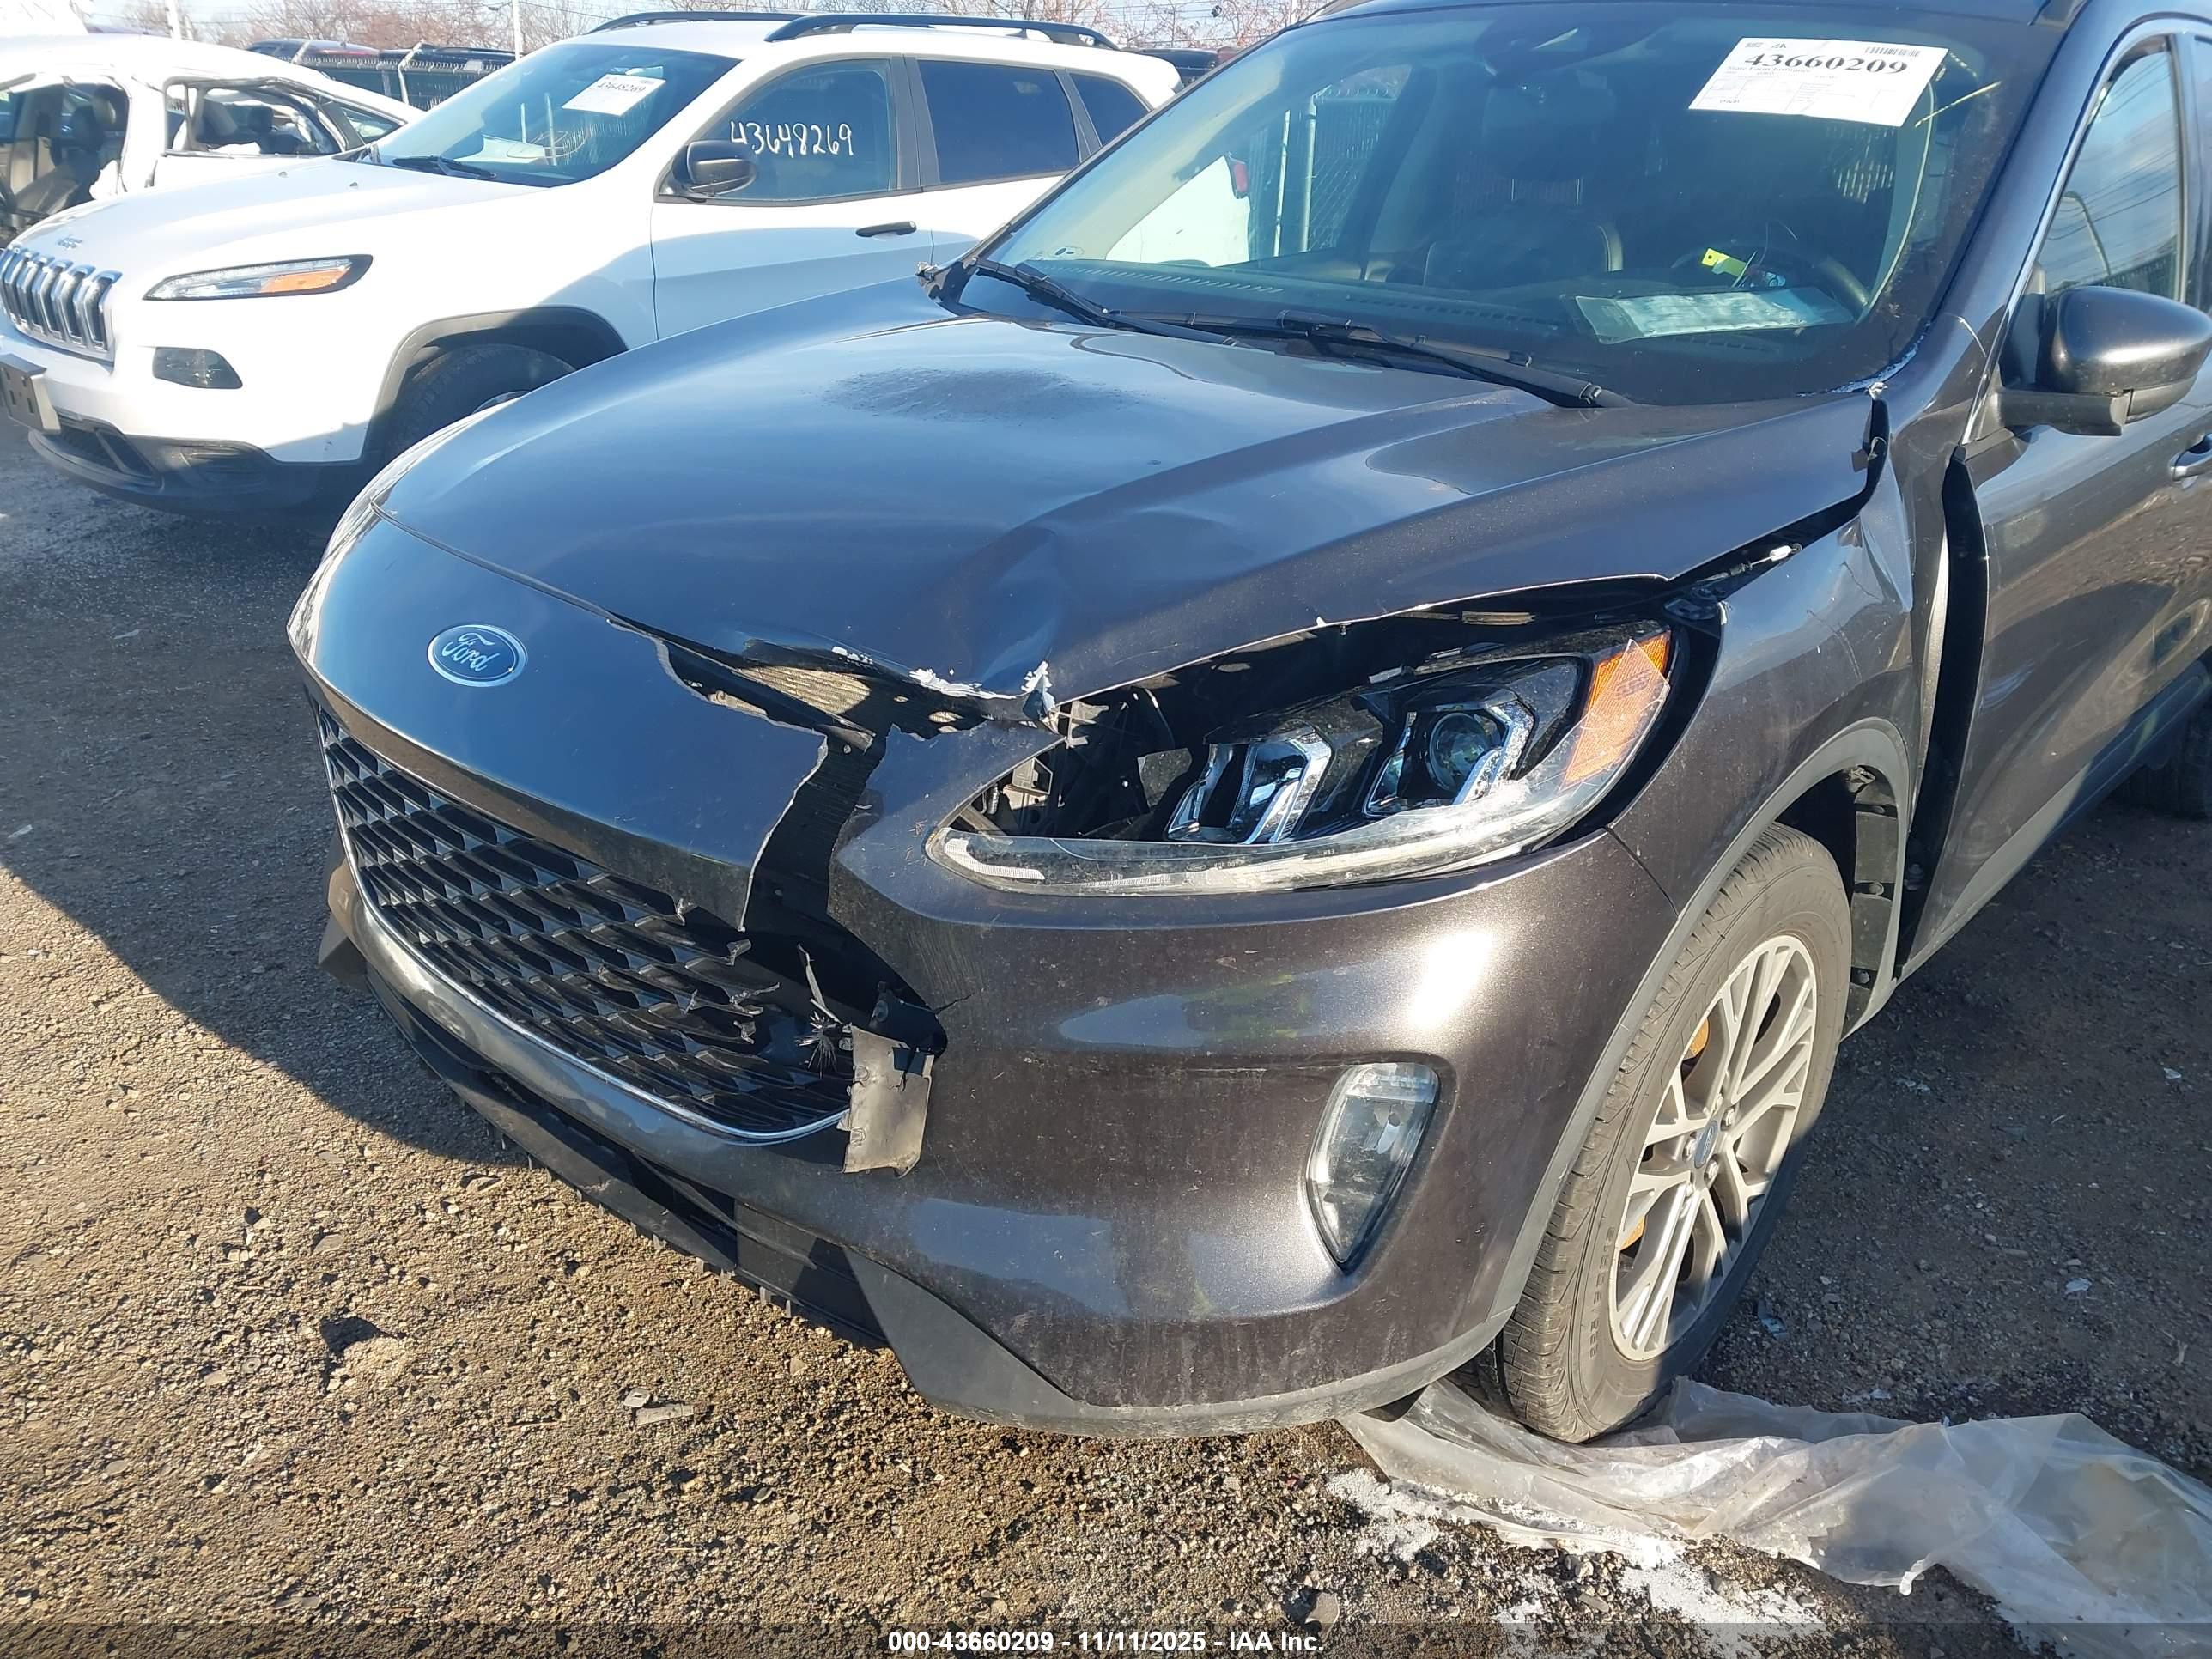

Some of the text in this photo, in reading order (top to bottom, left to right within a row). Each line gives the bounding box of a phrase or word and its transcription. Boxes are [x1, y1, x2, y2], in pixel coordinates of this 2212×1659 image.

[1744, 52, 1908, 75] 43660209
[730, 120, 854, 159] 43648269
[441, 632, 501, 672] Ford
